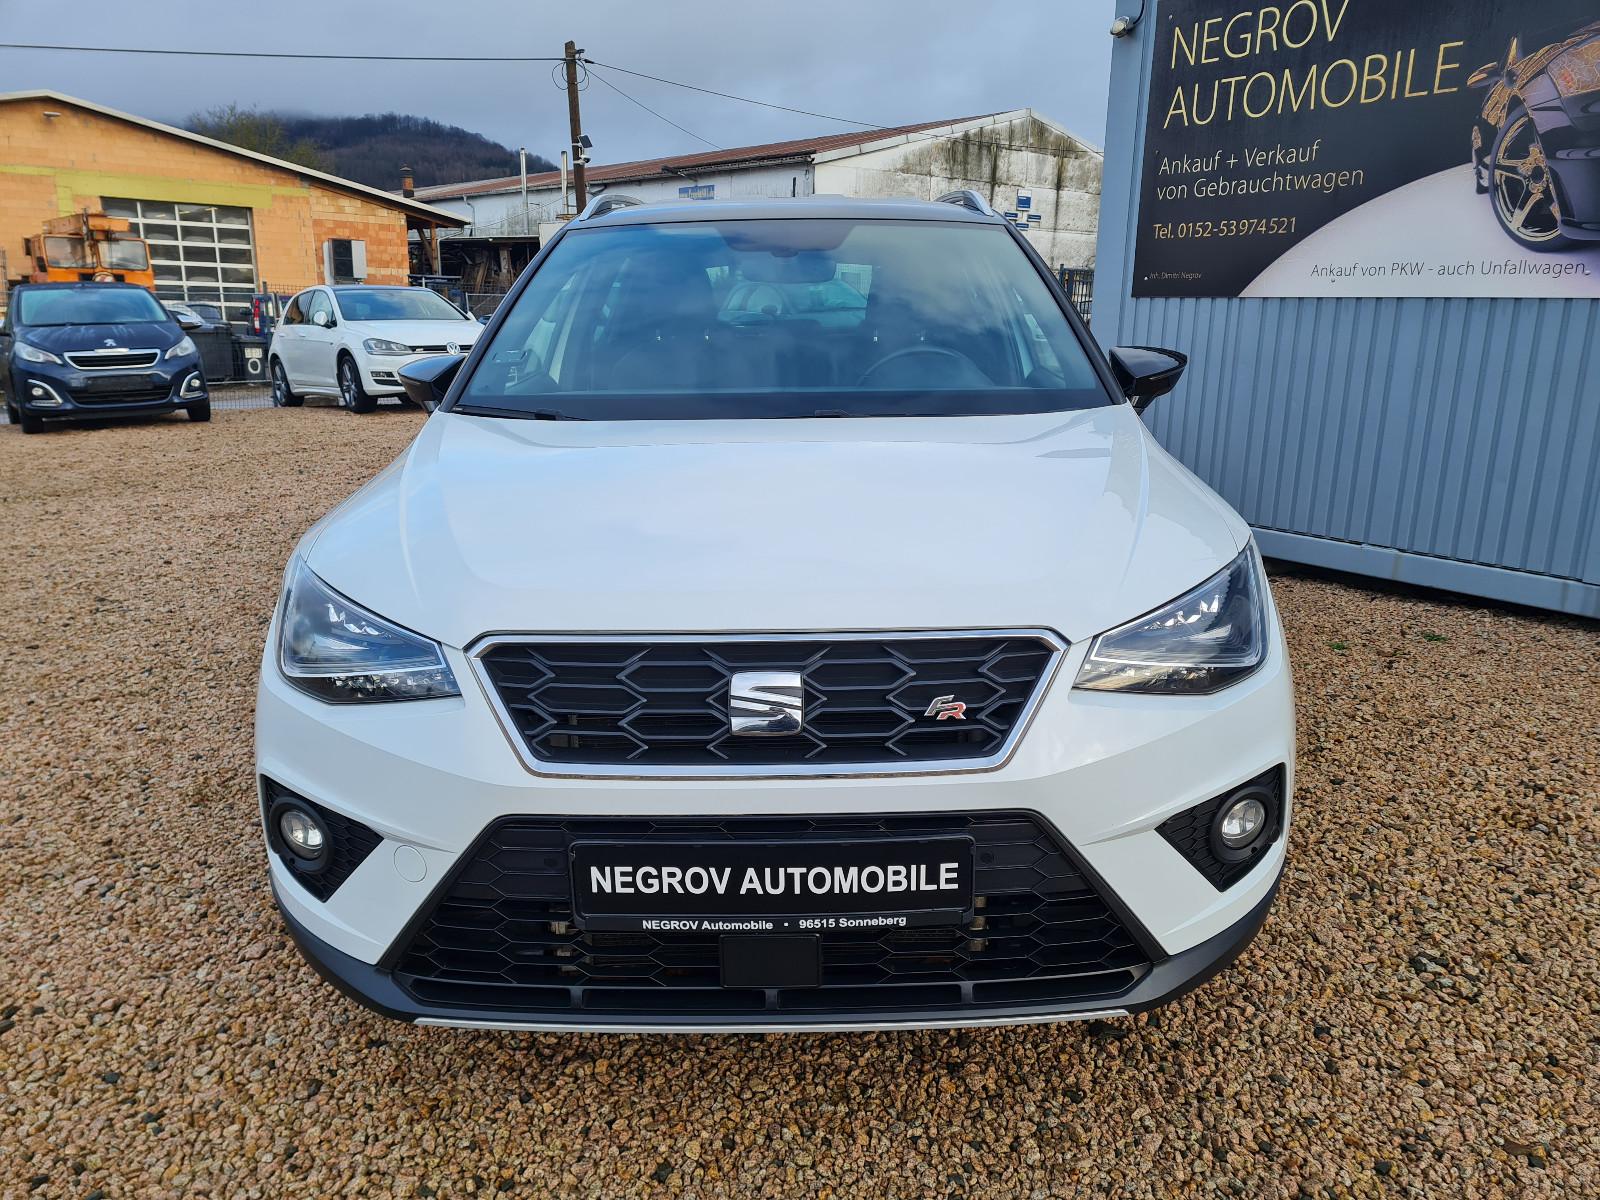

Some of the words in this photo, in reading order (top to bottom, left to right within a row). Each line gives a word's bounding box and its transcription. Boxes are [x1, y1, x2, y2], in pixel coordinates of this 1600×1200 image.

[1171, 0, 1350, 69] NEGROV
[1164, 40, 1463, 129] AUTOMOBILE
[1159, 150, 1222, 175] Ankauf
[1226, 154, 1239, 169] +
[1245, 138, 1321, 168] Verkauf
[1157, 182, 1187, 200] von
[1194, 168, 1364, 197] Gebrauchtwagen
[1153, 223, 1174, 239] Tel.
[1178, 217, 1297, 238] 0152-53974521
[1311, 263, 1359, 276] Ankauf
[1361, 266, 1385, 276] von
[1391, 262, 1424, 276] PKW
[1437, 261, 1475, 276] auch
[1481, 260, 1586, 278] Unfallwagen
[924, 694, 966, 721] FR
[590, 866, 731, 895] NEGROV
[739, 862, 959, 895] AUTOMOBILE
[642, 920, 698, 931] NEGROV
[701, 919, 773, 931] Automobile
[798, 918, 836, 930] 96515
[839, 915, 907, 930] Sonneberg
